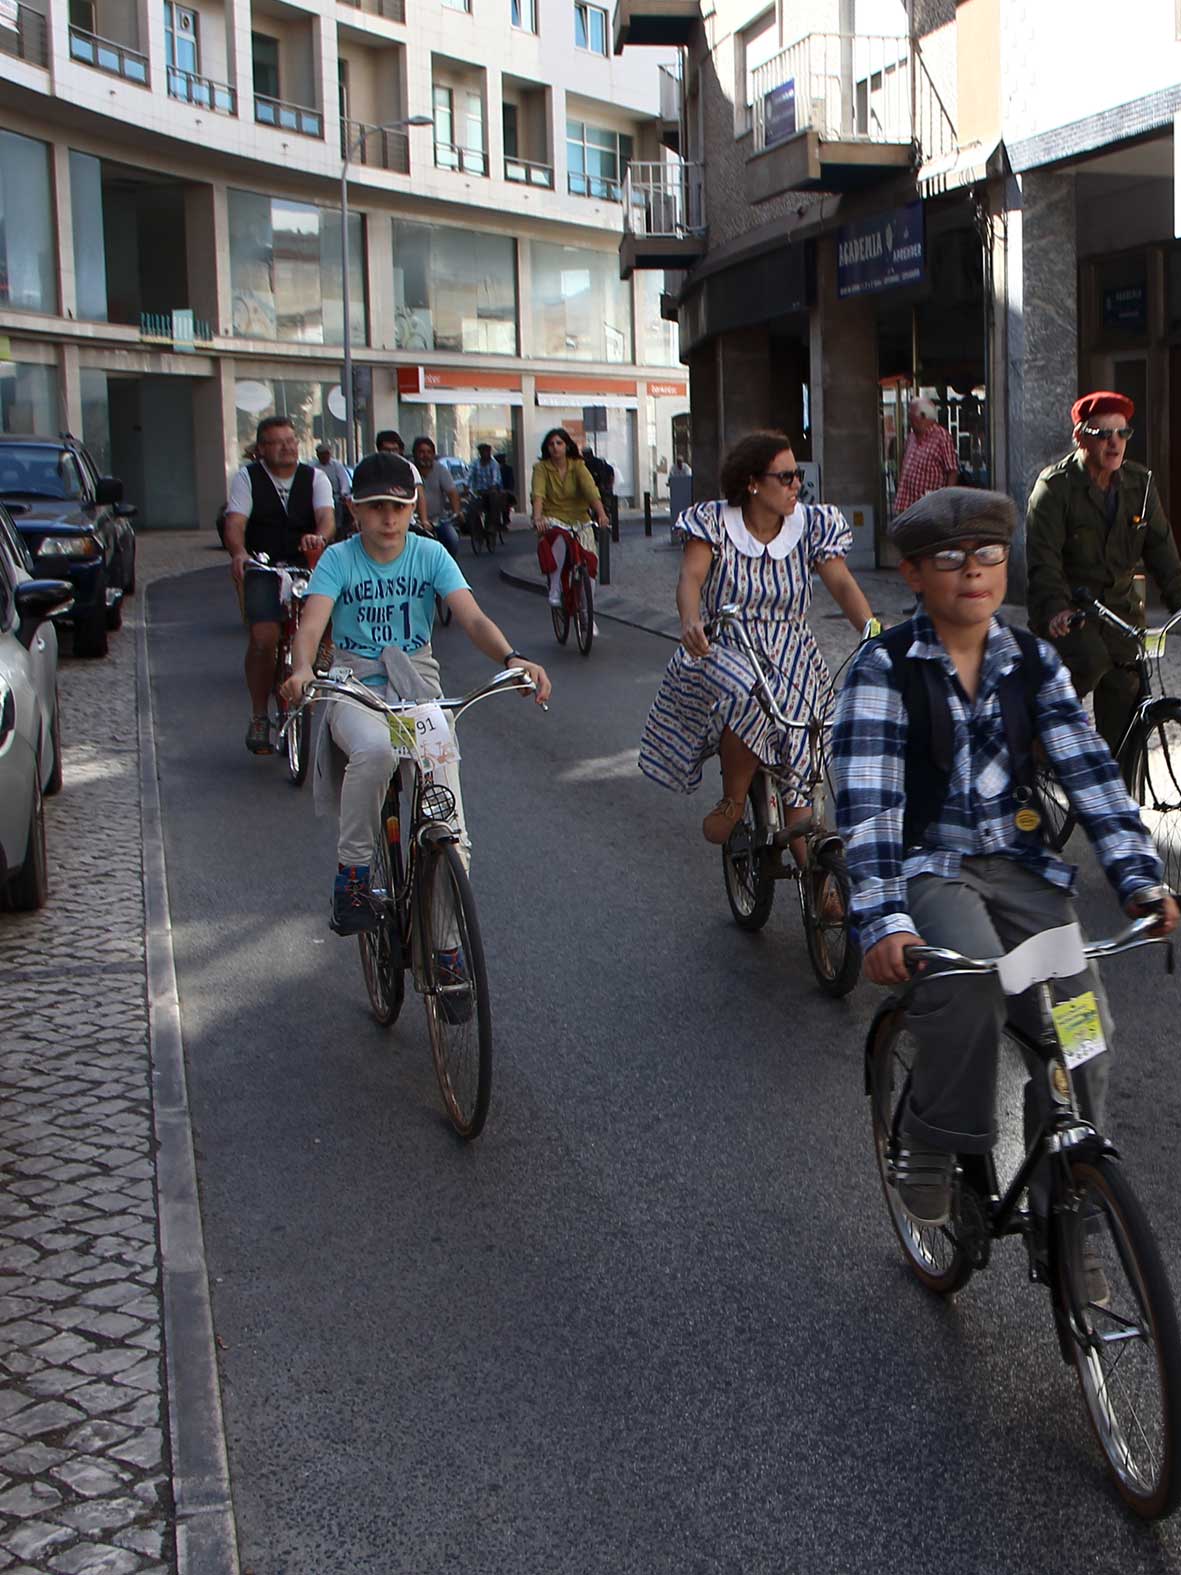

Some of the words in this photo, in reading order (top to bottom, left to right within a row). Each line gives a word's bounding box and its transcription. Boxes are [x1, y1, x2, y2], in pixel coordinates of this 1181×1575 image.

[839, 231, 882, 267] ACADEMIA
[357, 605, 395, 623] SURF
[400, 602, 410, 640] 1
[371, 625, 398, 642] CO.
[416, 717, 436, 735] 91
